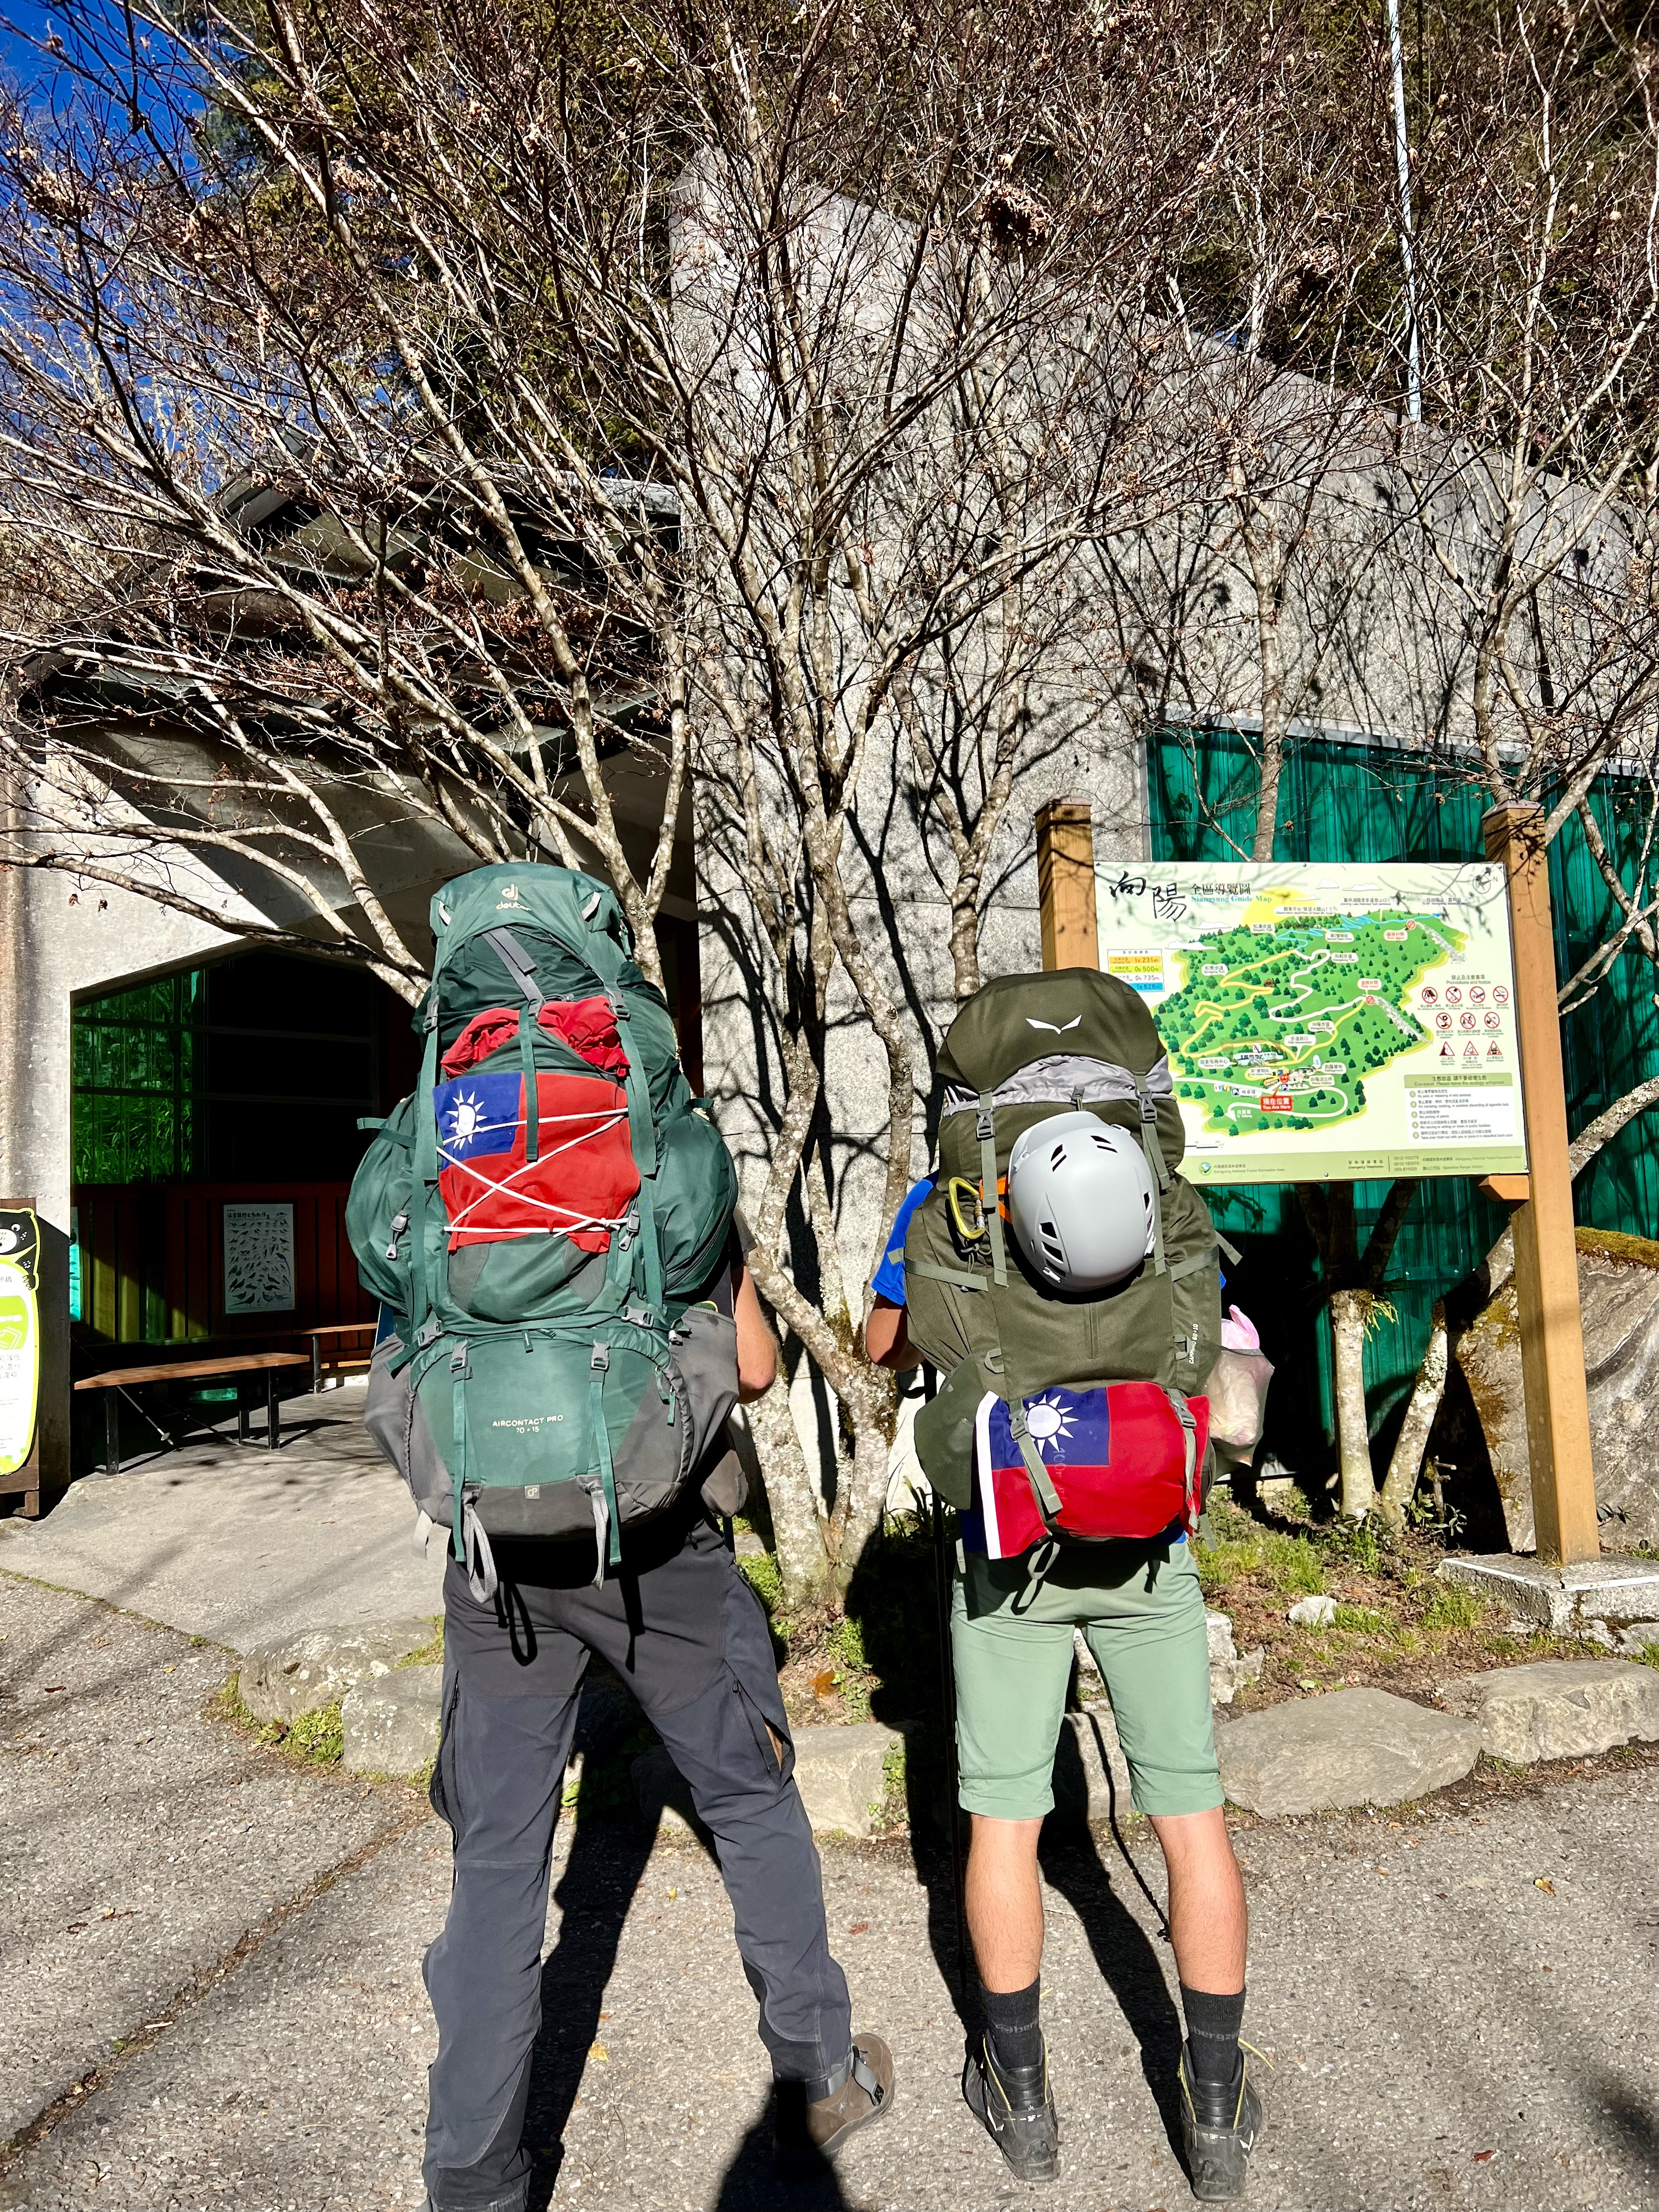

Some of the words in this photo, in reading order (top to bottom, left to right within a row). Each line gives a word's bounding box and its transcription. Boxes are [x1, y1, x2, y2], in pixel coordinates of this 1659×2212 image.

[1190, 883, 1251, 895] 全區導覽圖
[1109, 870, 1187, 922] 向陽
[1256, 895, 1272, 904] Map
[492, 1417, 545, 1427] AIRCONTACT
